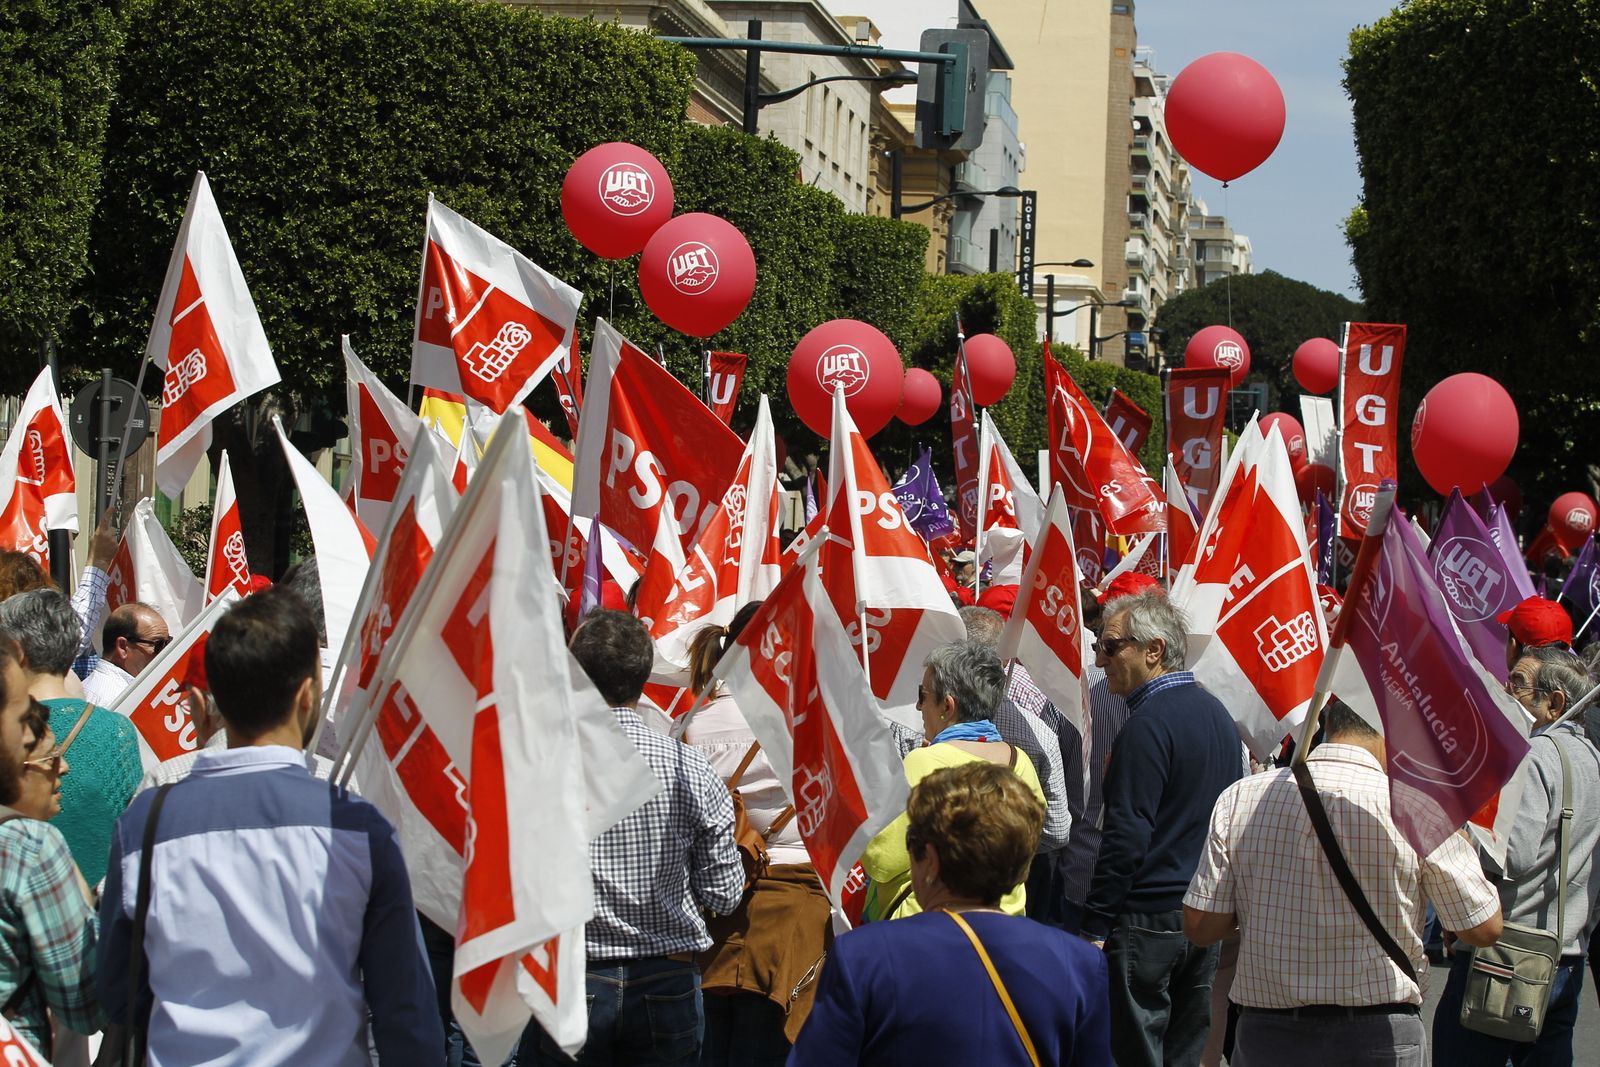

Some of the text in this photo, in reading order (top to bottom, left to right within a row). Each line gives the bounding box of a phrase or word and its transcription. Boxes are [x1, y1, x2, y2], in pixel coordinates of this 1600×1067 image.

[605, 170, 649, 193] UGT
[1024, 196, 1032, 240] hotel
[671, 248, 709, 274] UGT
[823, 352, 866, 376] UGT
[1218, 345, 1241, 360] UGT
[1354, 343, 1394, 474] UGT
[1356, 491, 1375, 507] UG
[1448, 542, 1502, 600] UGT
[1379, 664, 1414, 711] MERÍA
[1381, 641, 1457, 754] Andalucía
